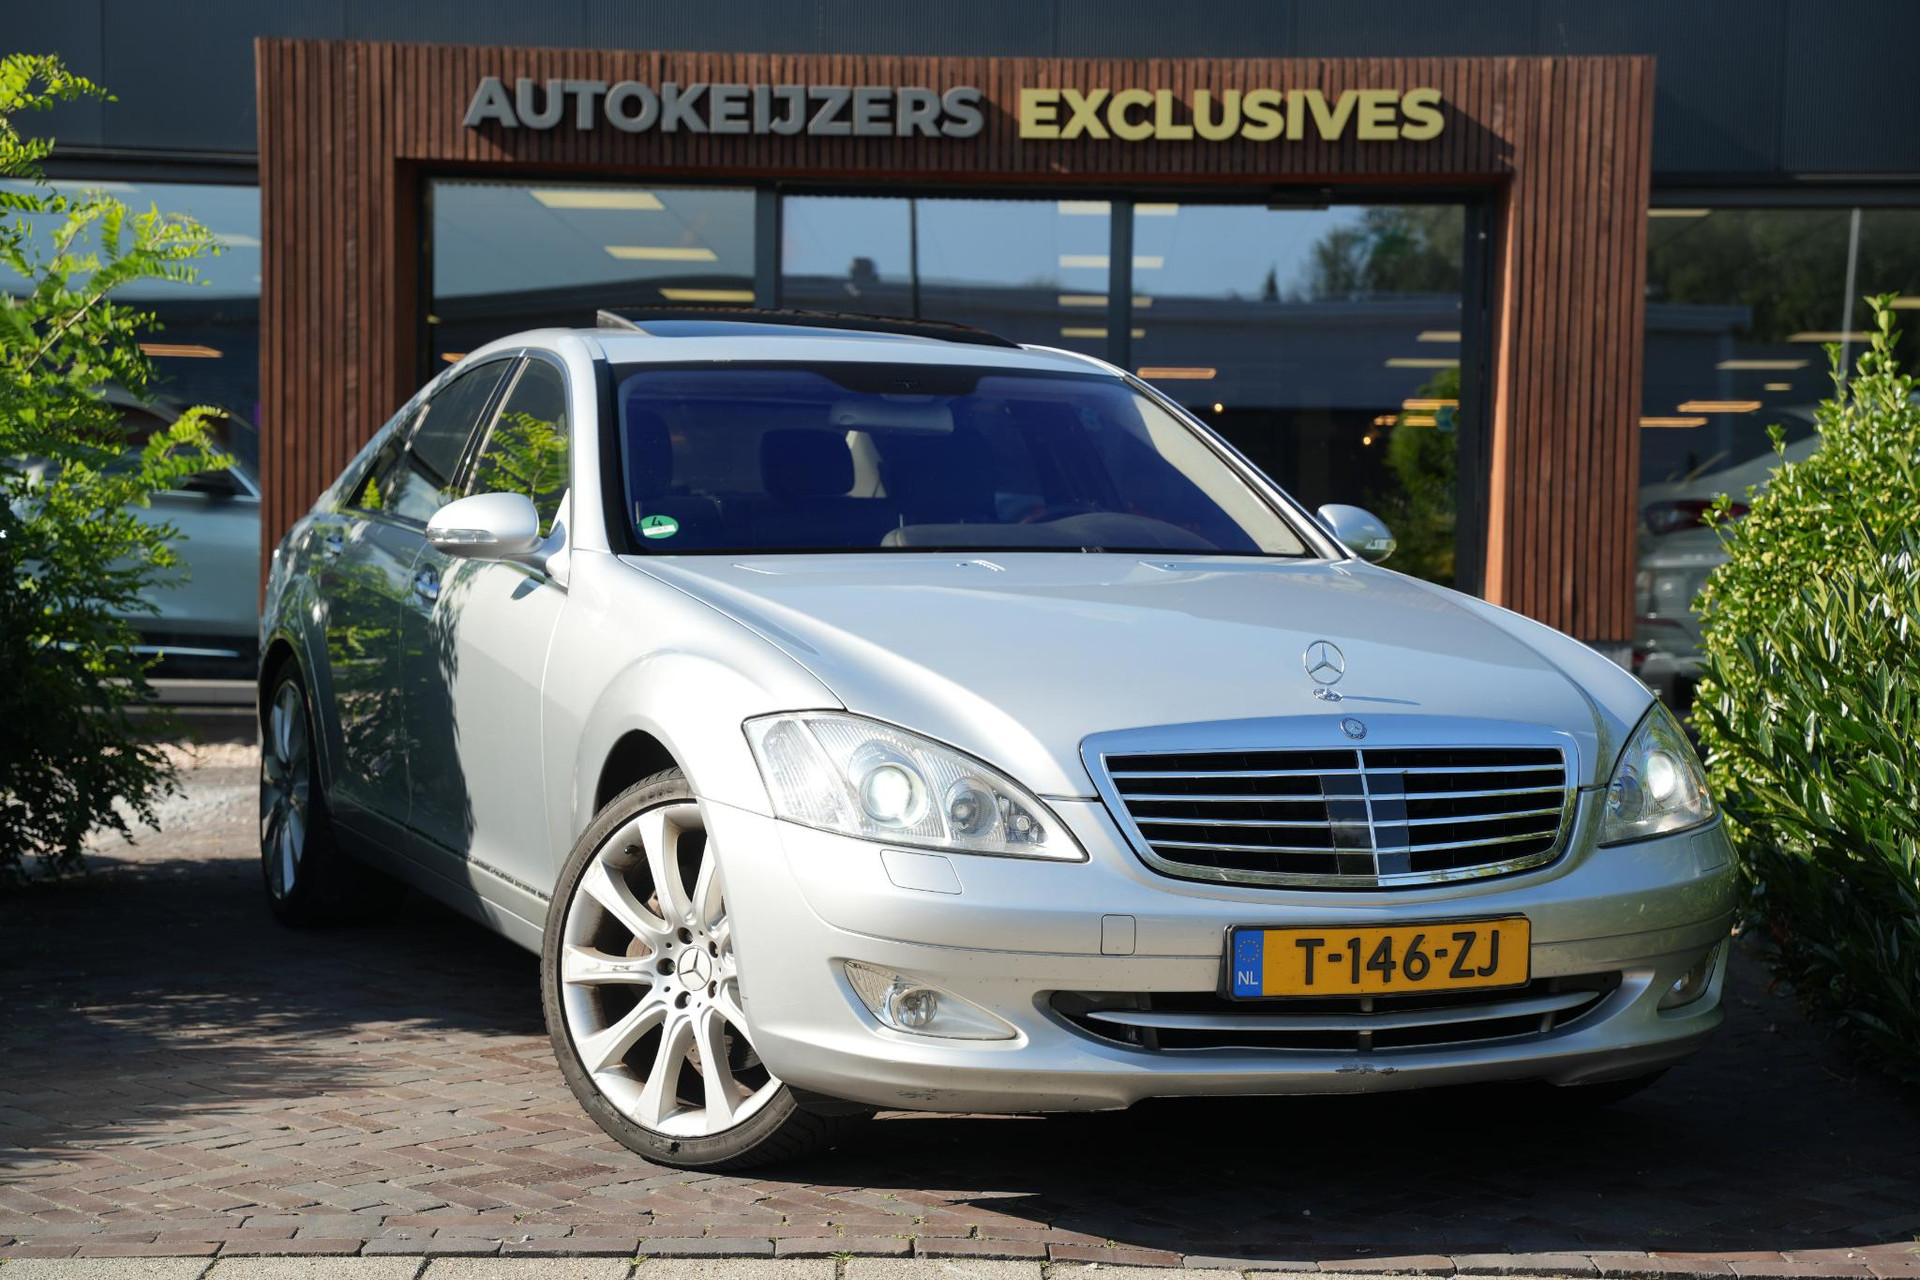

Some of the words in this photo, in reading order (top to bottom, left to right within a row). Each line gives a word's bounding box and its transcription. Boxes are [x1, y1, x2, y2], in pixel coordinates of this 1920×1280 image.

[462, 76, 985, 138] AUTOKEIJZERS
[1019, 87, 1445, 141] EXCLUSIVES
[651, 516, 663, 527] 4
[1295, 930, 1500, 985] T-146-ZJ
[1238, 971, 1258, 985] NL
